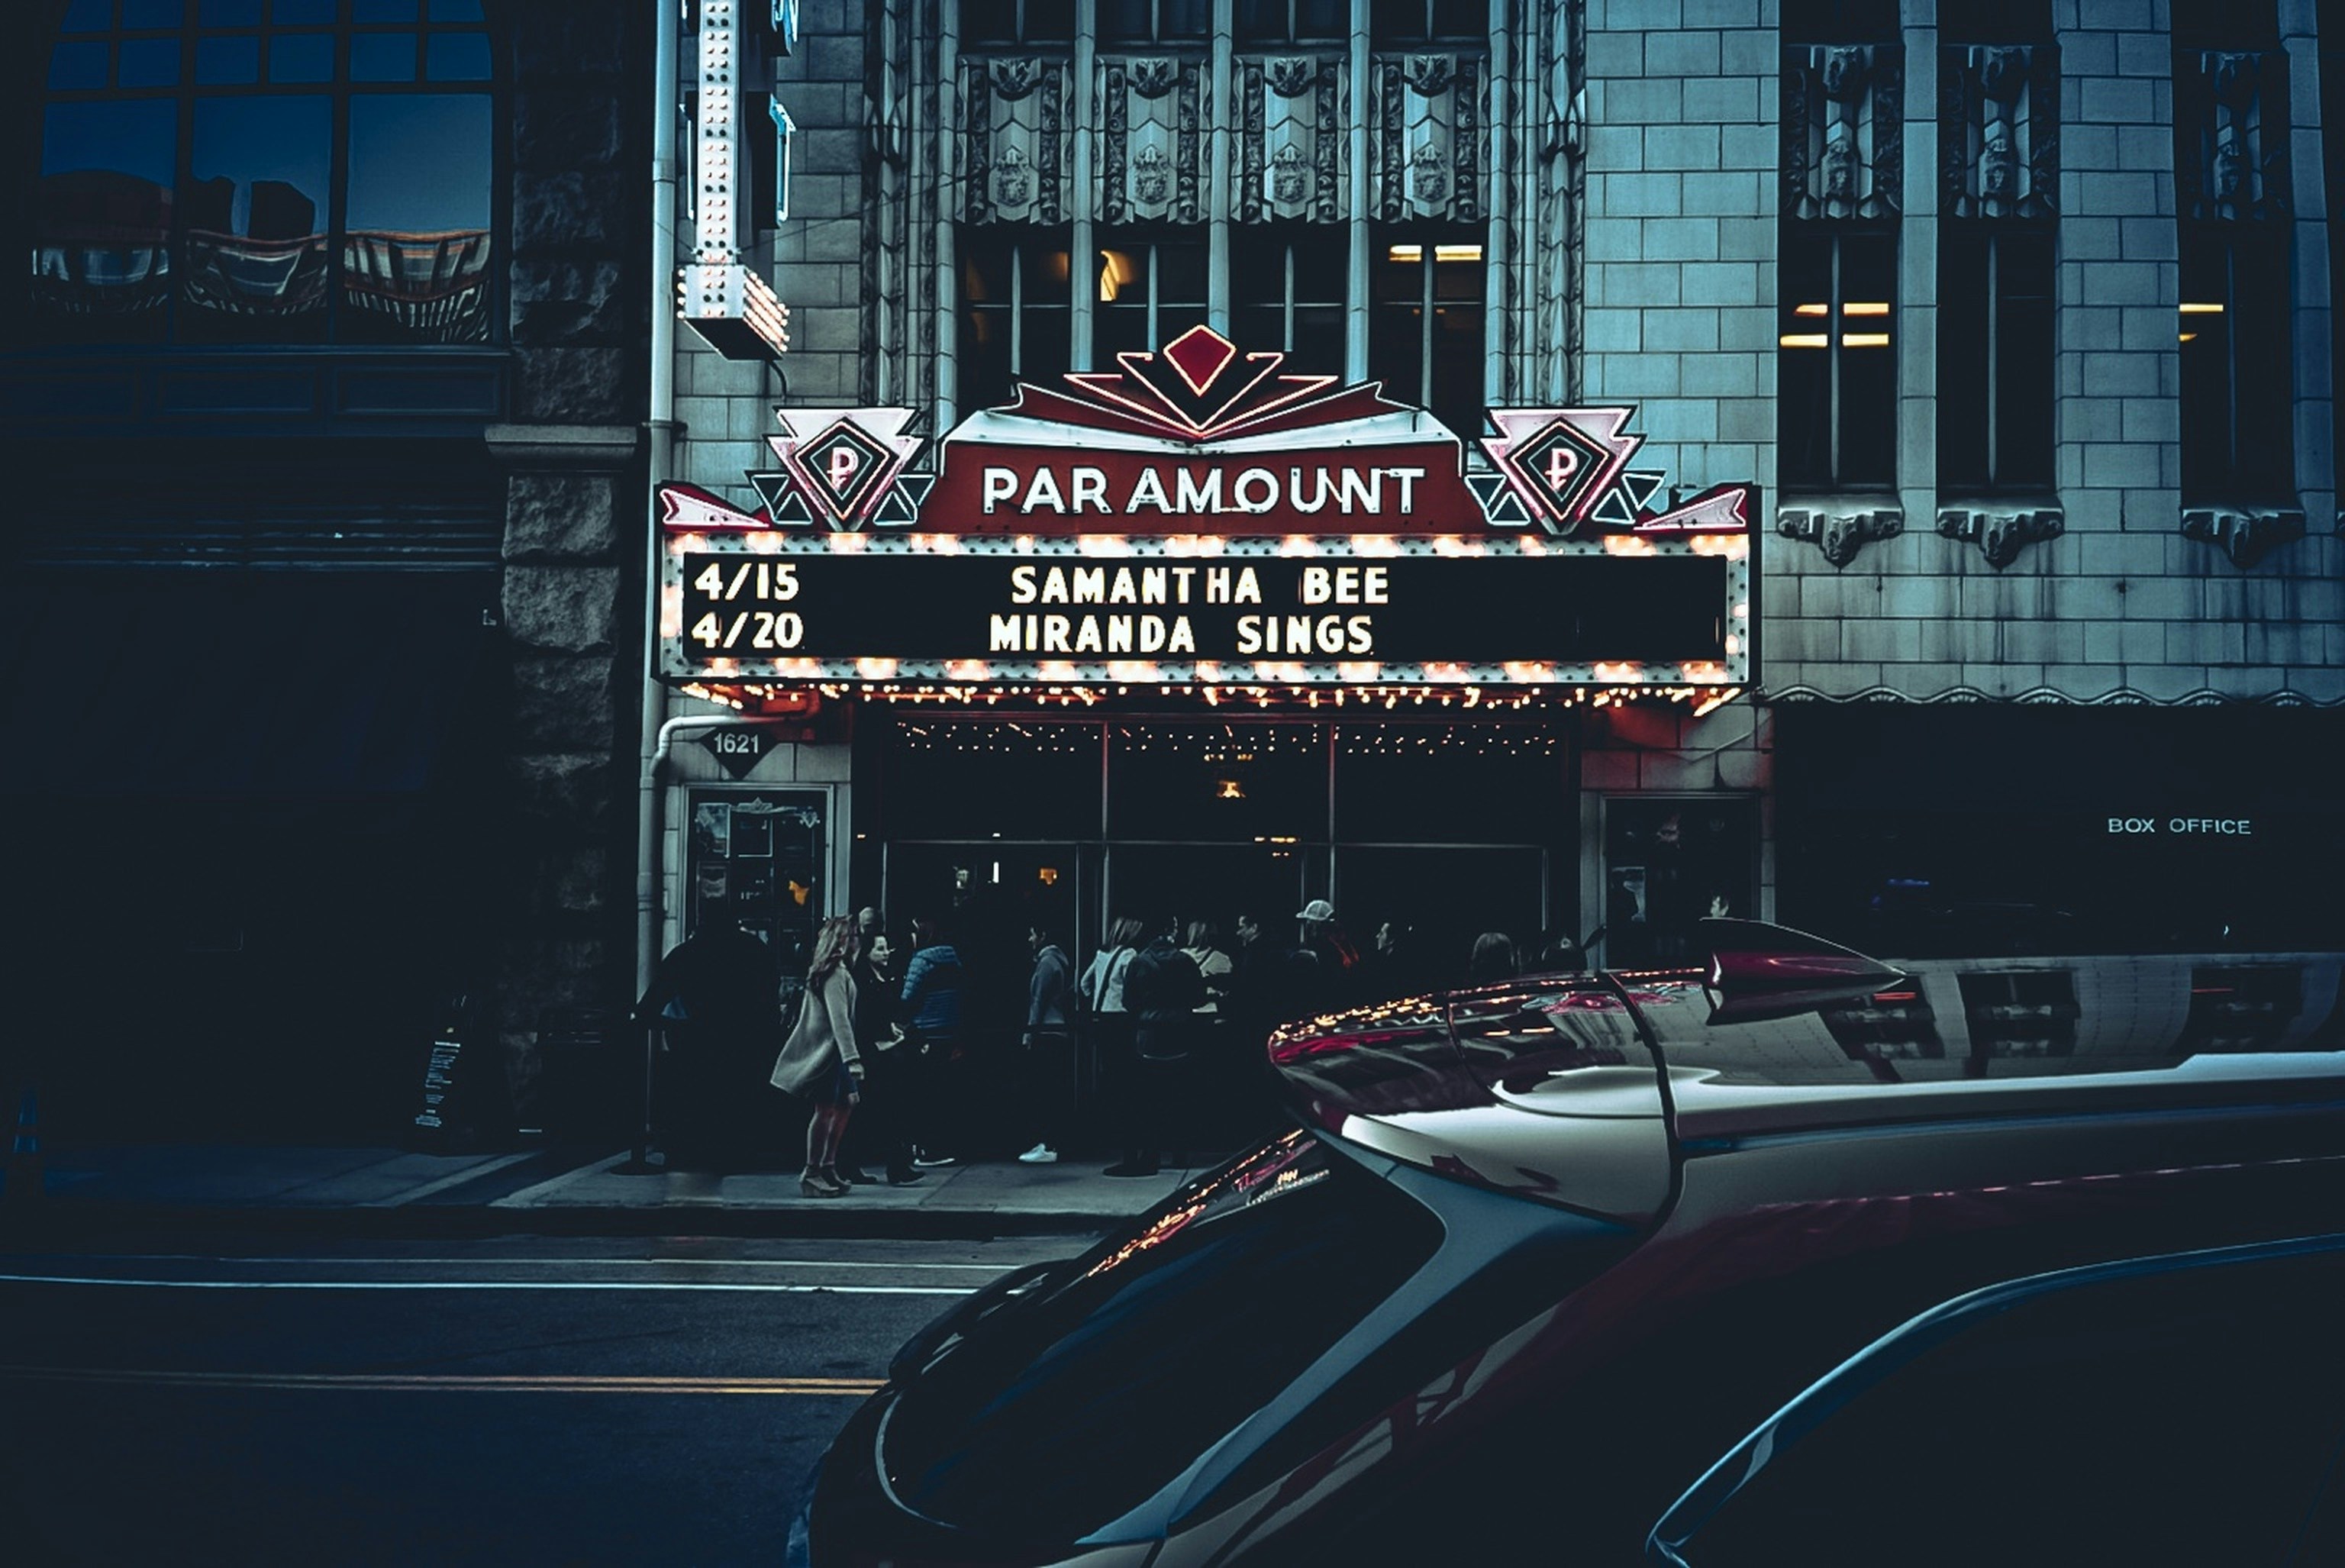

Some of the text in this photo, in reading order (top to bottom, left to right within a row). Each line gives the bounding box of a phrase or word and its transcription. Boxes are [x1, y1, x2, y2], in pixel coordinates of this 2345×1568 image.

[983, 466, 1425, 515] PARAMOUNT
[694, 562, 1389, 605] 4/15 SAMANTHA BEE
[692, 611, 1372, 654] 4/20 MIRANDA SINGS
[714, 733, 759, 753] 1621
[2107, 818, 2251, 835] BOX OFFICE
